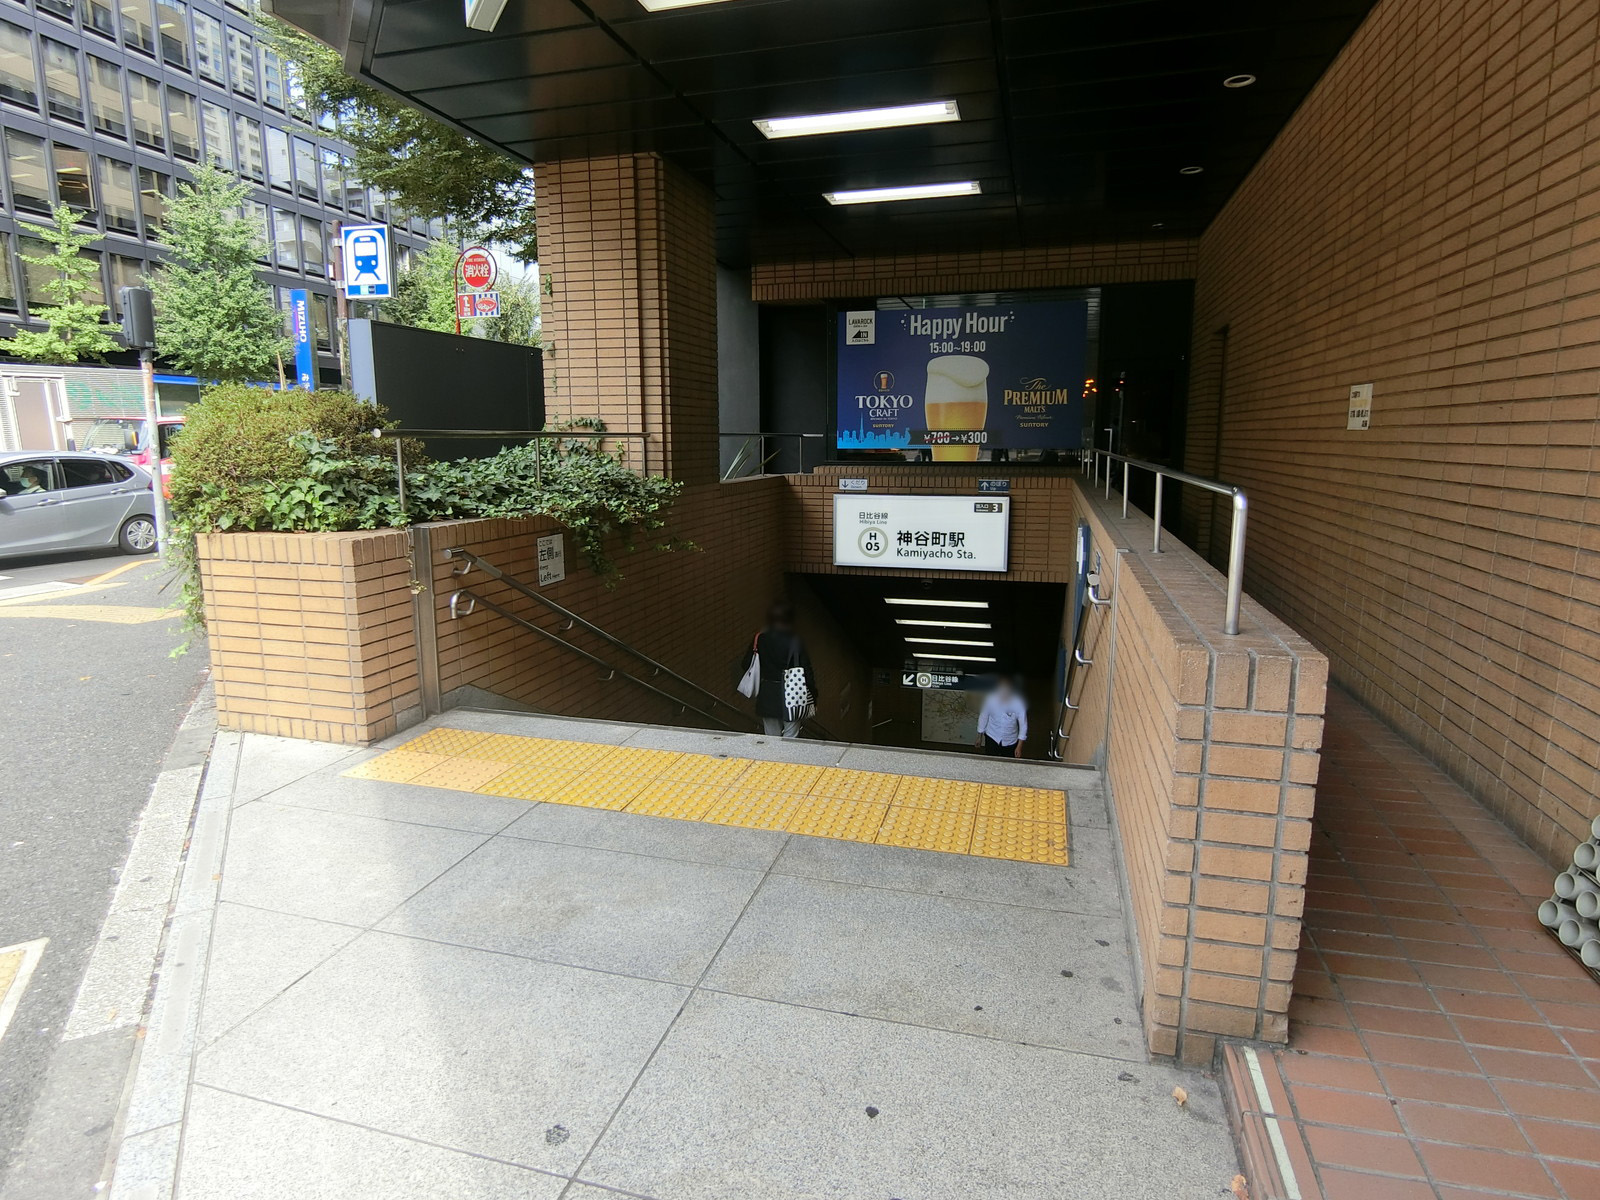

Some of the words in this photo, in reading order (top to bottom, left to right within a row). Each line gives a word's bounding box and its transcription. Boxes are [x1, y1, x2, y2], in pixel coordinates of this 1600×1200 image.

[465, 264, 489, 277] 消火栓
[296, 300, 307, 343] MIZUHO
[910, 314, 962, 340] Happy
[965, 312, 1008, 334] Hour
[1020, 377, 1051, 391] The
[855, 395, 913, 409] TOKYO
[1003, 388, 1068, 406] PREMIUM
[869, 408, 899, 418] CRAFT
[961, 431, 988, 444] ¥300
[992, 503, 999, 512] 3
[859, 511, 889, 520] 日比谷線
[869, 532, 877, 541] H
[896, 530, 965, 548] 神谷町駅
[865, 541, 880, 551] 05
[896, 547, 954, 561] Kamiyacho
[956, 549, 976, 559] Sta.
